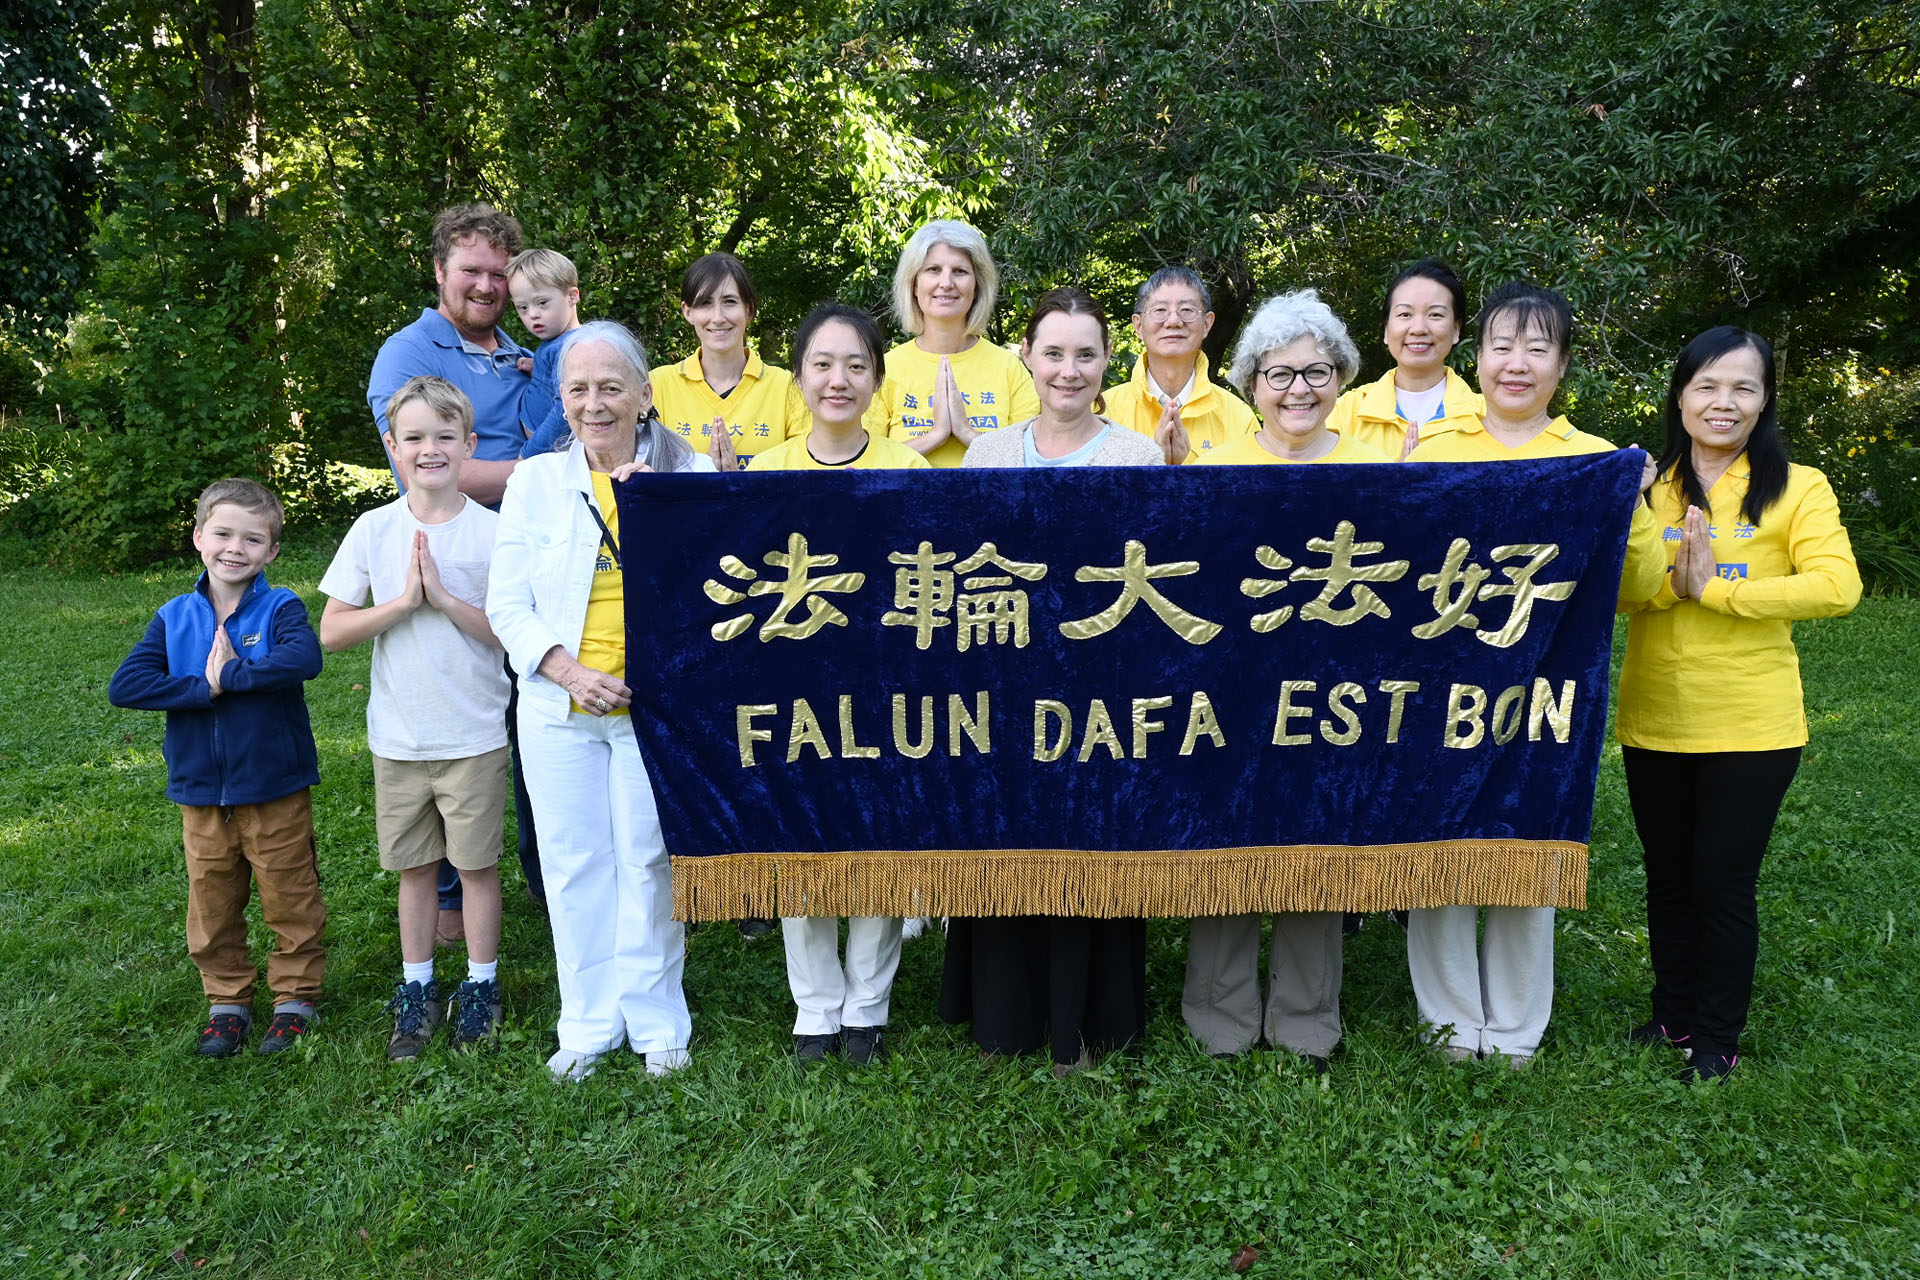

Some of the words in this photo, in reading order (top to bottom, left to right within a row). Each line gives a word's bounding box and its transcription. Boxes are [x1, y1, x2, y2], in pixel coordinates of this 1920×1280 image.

[904, 415, 934, 427] FAL
[967, 416, 996, 427] AFA
[1661, 522, 1756, 541] 輪大法
[704, 520, 1577, 653] 法輪大法好
[736, 690, 991, 768] FALUN
[1033, 690, 1226, 763] DAFA
[1272, 679, 1420, 746] EST
[1444, 676, 1577, 749] BON
